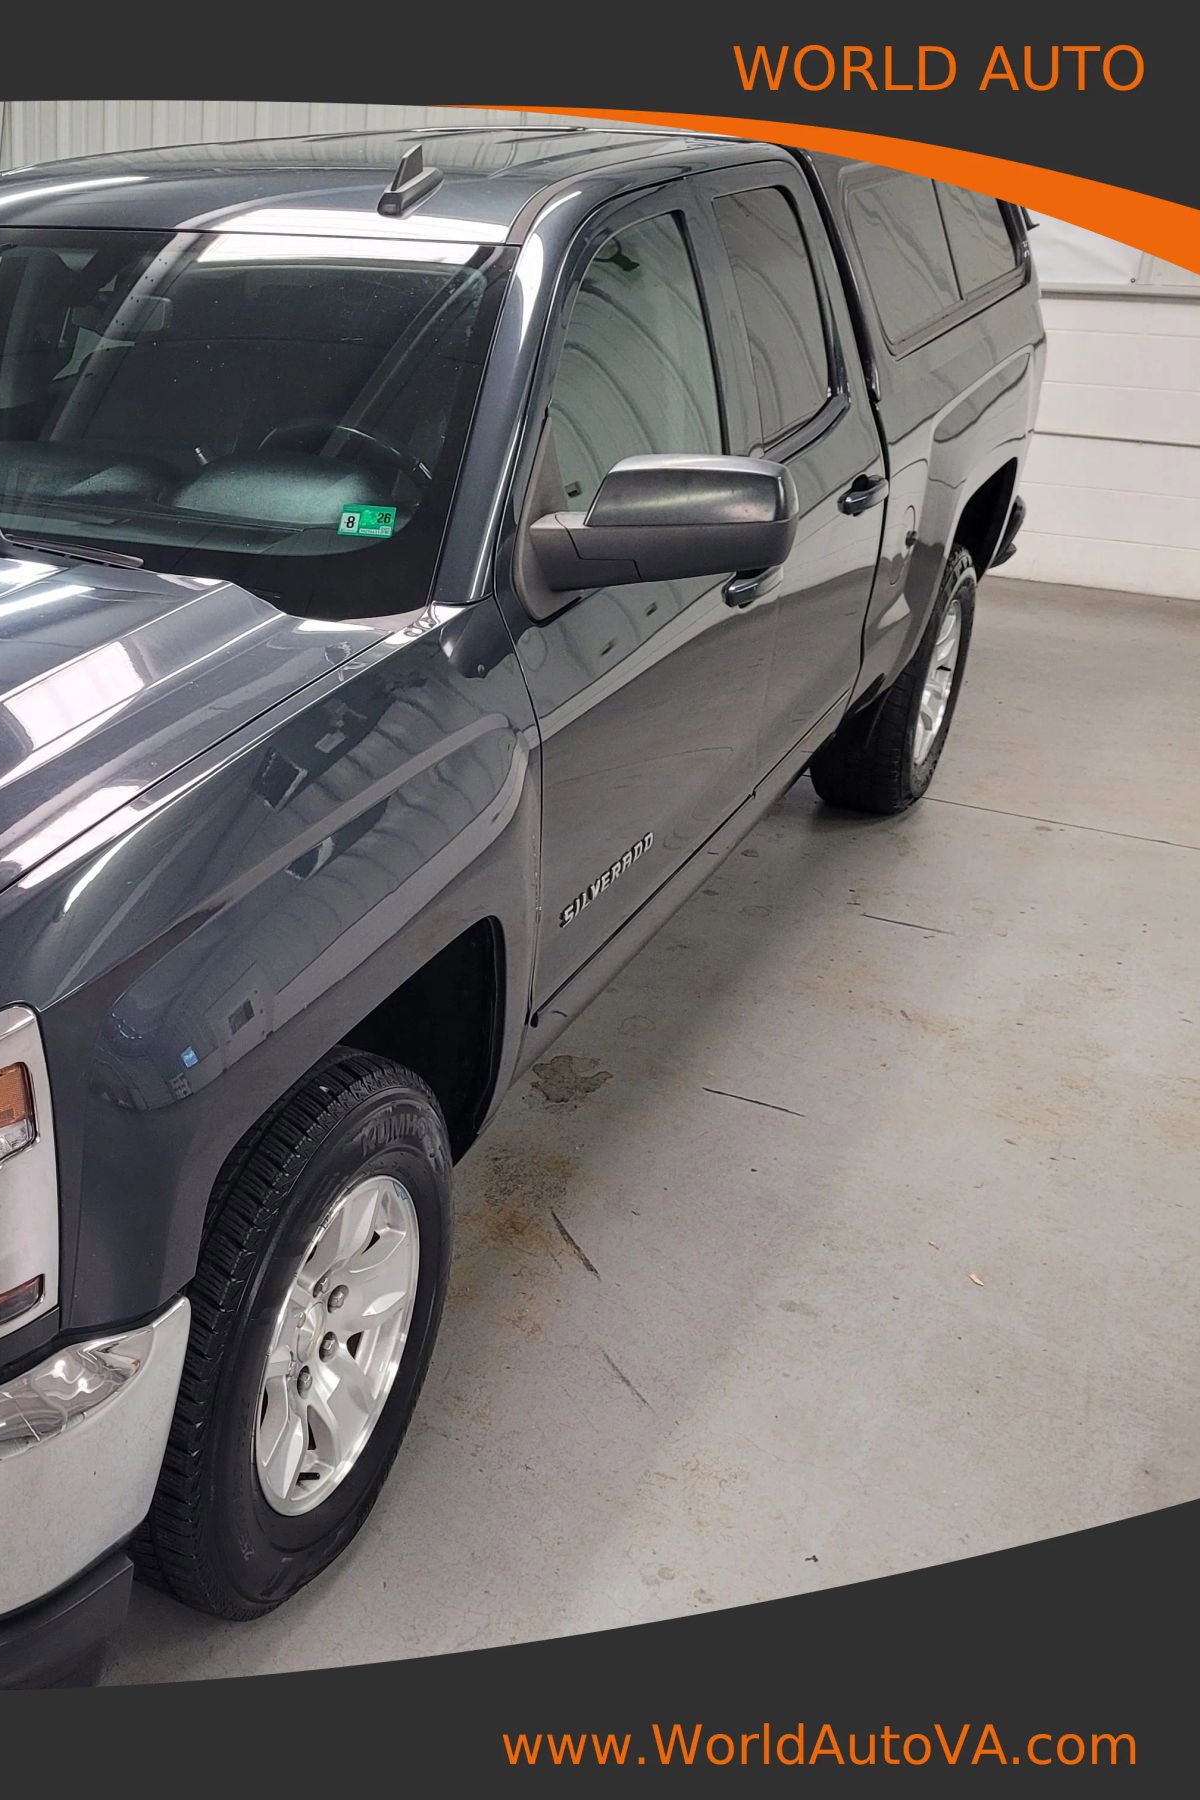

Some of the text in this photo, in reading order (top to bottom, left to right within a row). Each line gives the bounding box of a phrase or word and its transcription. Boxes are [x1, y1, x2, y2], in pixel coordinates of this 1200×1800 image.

[346, 515, 356, 529] 8
[376, 512, 392, 524] 26
[558, 831, 655, 929] SILVERADO
[362, 1113, 427, 1156] KUMHO
